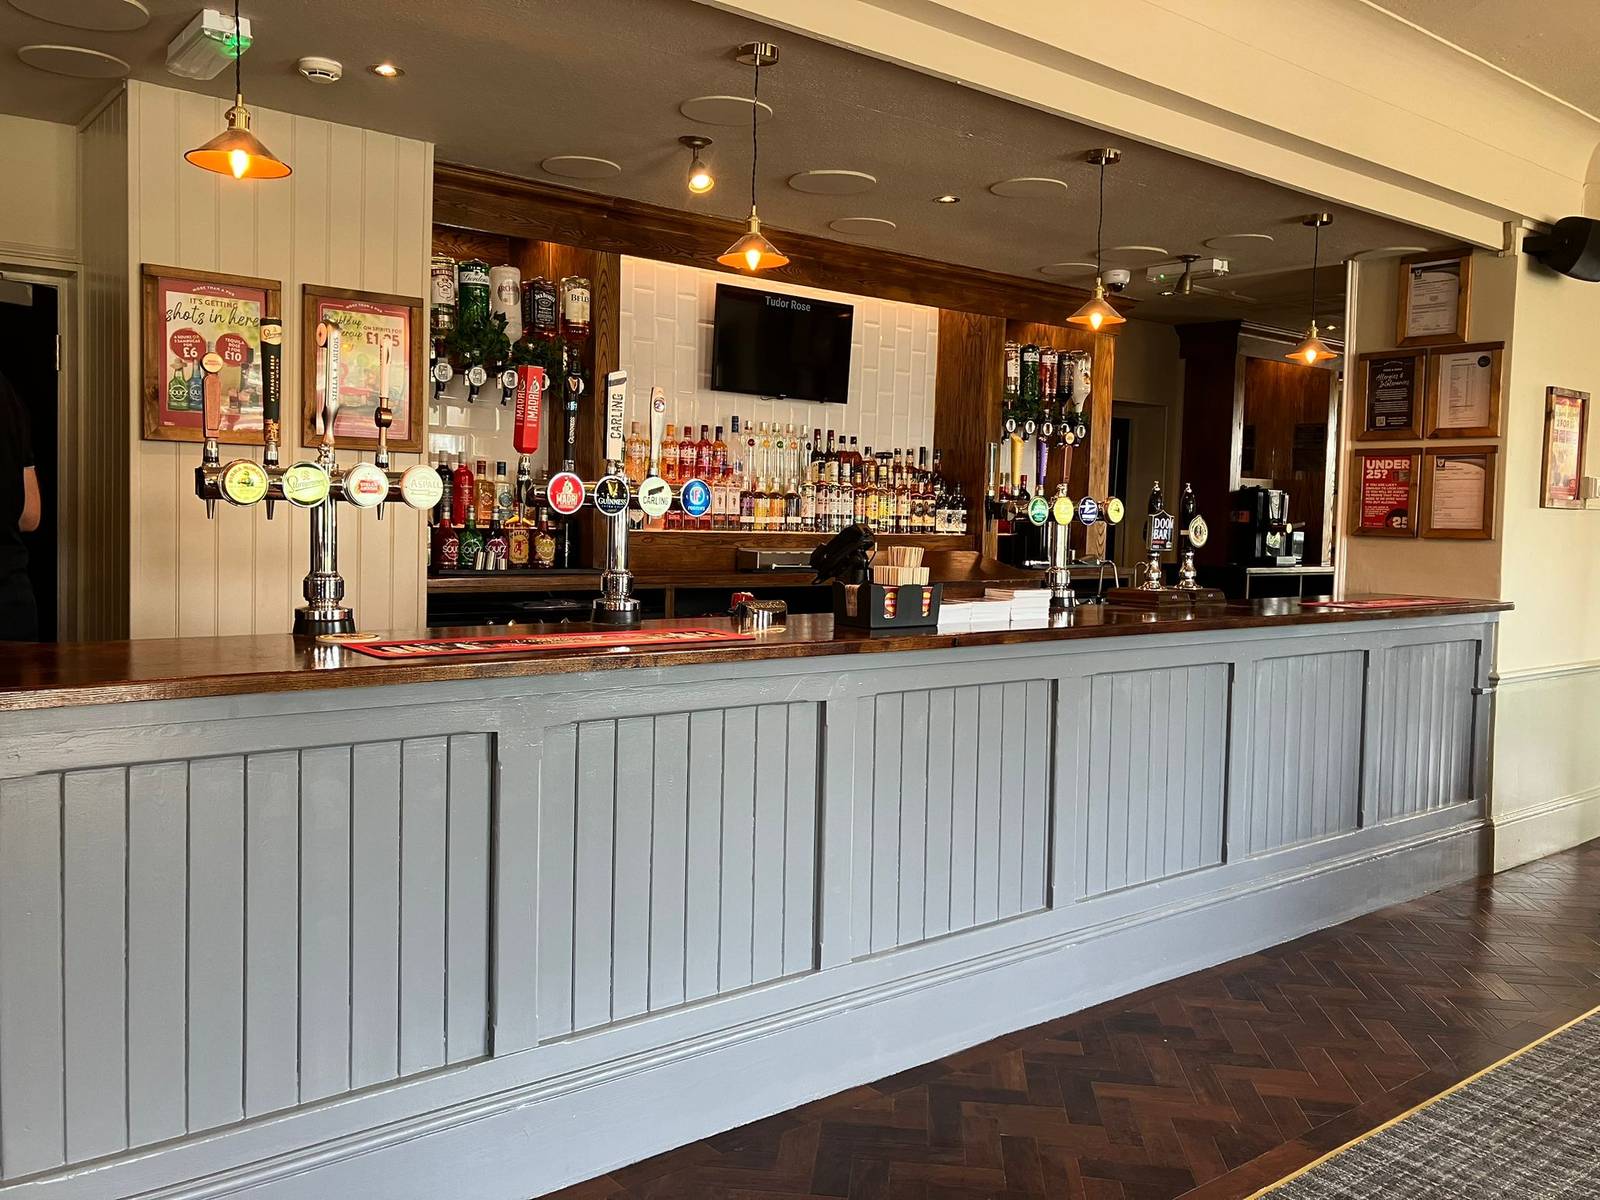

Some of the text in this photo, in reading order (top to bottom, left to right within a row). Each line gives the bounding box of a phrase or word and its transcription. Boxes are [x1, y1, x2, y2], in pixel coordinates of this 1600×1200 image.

[204, 300, 238, 309] GETTING
[765, 295, 811, 312] Tudor Rose
[165, 301, 260, 327] shots in here
[352, 319, 363, 328] up
[372, 325, 391, 333] SPIRITS
[225, 337, 245, 345] TEQUILA
[183, 347, 198, 358] £6
[224, 350, 242, 362] £10
[610, 393, 624, 439] CARLING
[568, 416, 576, 444] GUINNESS
[1366, 459, 1410, 469] UNDER
[1366, 470, 1388, 479] 25?
[411, 480, 442, 489] ASPALL
[598, 497, 627, 506] GUINNESS
[642, 496, 668, 506] CARLING
[1392, 516, 1408, 528] 25
[1153, 529, 1168, 540] BAR
